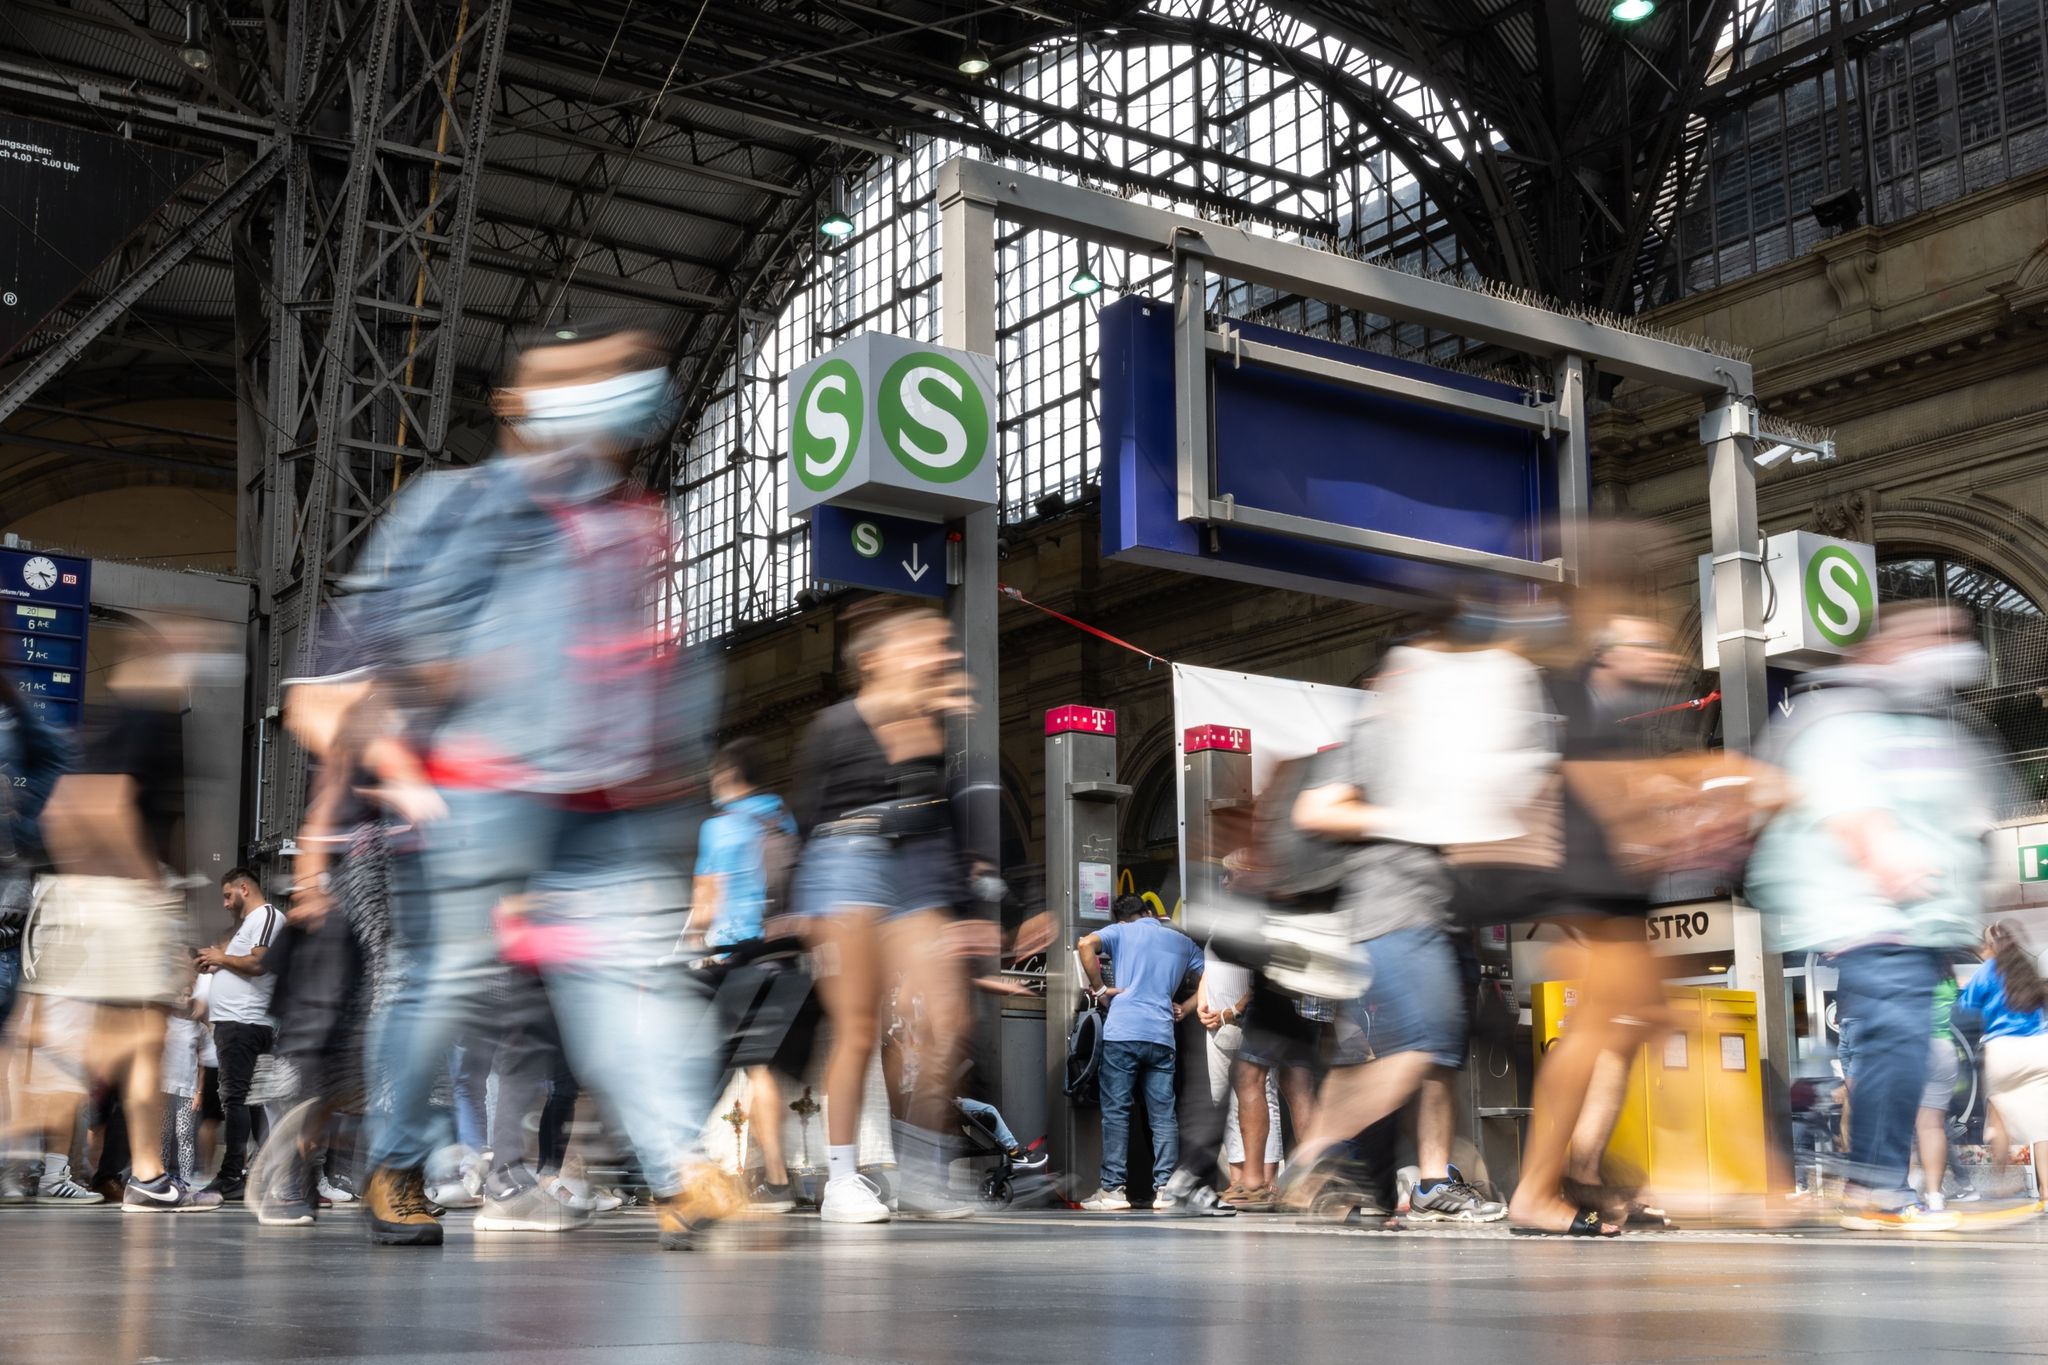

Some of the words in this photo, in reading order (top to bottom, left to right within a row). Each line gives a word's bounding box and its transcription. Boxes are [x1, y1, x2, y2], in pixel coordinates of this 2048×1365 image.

[12, 152, 32, 162] 4.00
[42, 158, 61, 168] 3.00
[63, 161, 81, 172] Uhr
[899, 366, 968, 468] S
[805, 374, 850, 477] S
[856, 522, 880, 555] S
[1818, 556, 1861, 636] S
[27, 607, 36, 615] 20
[28, 619, 35, 630] 6
[22, 637, 34, 648] 11
[27, 650, 34, 661] 7
[36, 651, 48, 659] A-C
[19, 681, 31, 692] 21
[33, 683, 47, 691] A-C
[13, 776, 27, 787] 22
[1647, 910, 1709, 941] STRO
